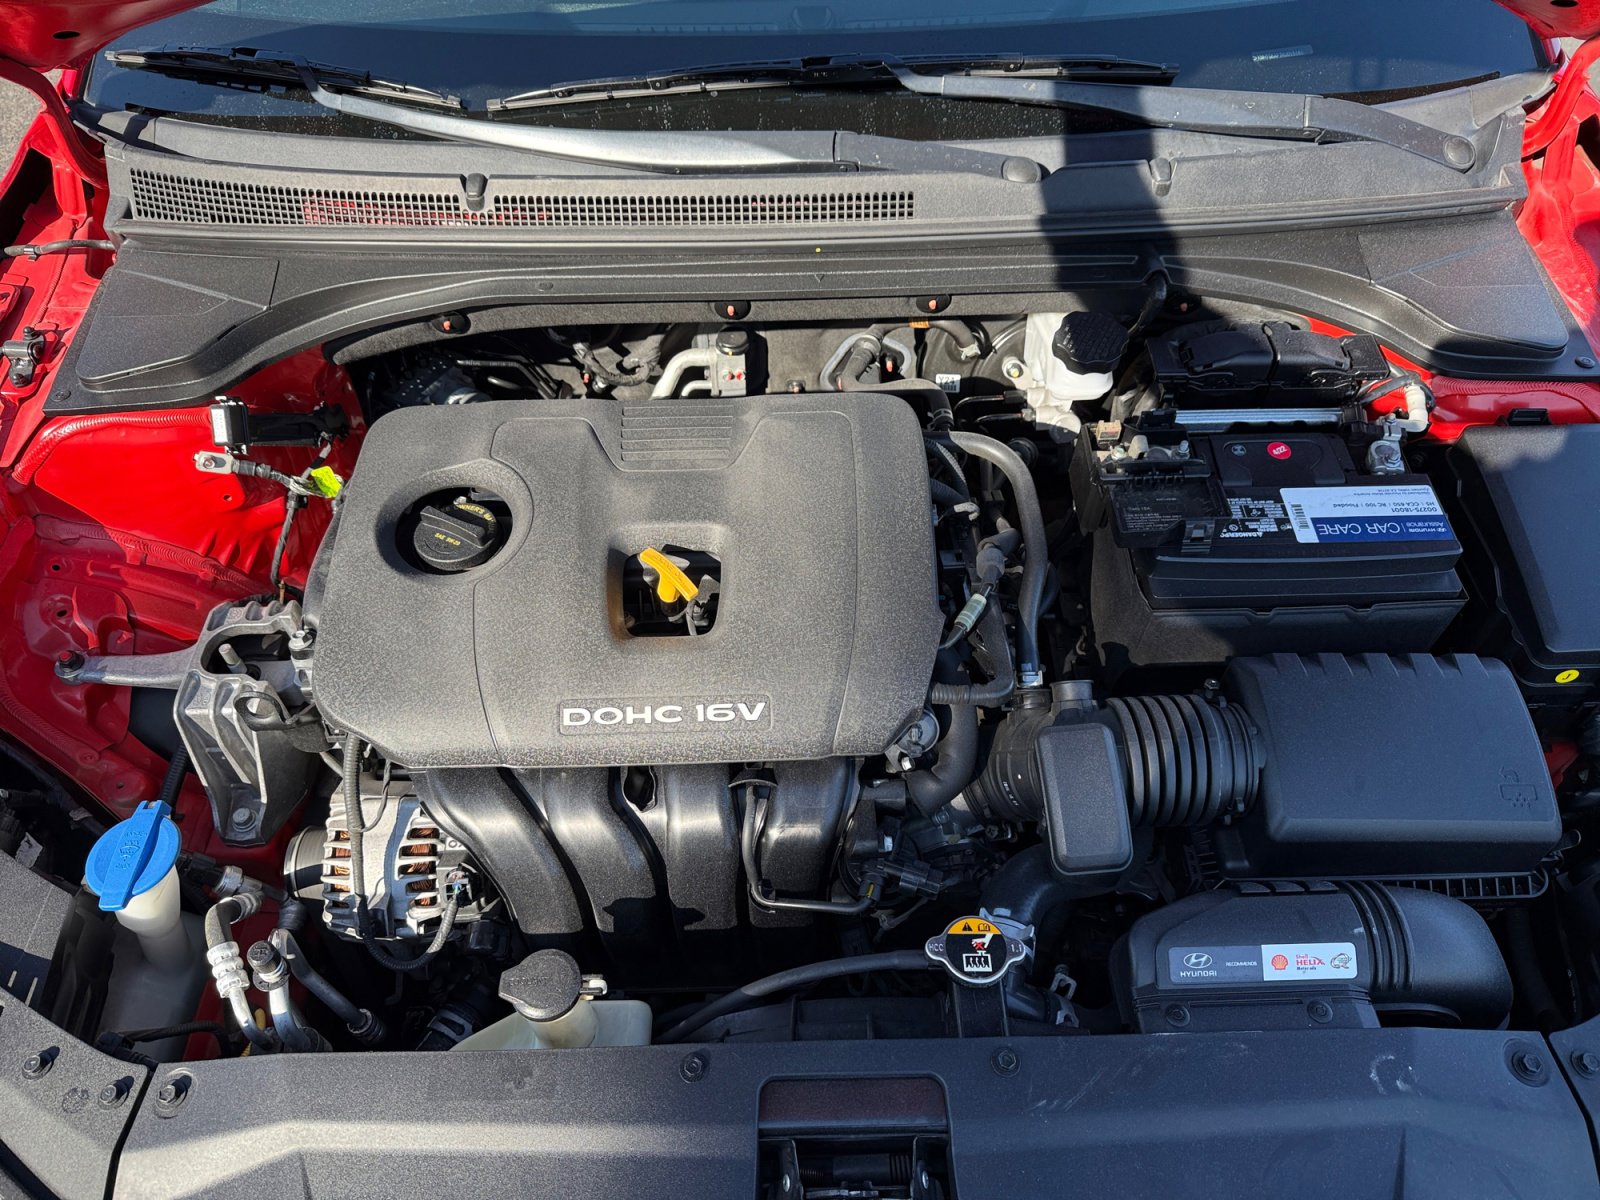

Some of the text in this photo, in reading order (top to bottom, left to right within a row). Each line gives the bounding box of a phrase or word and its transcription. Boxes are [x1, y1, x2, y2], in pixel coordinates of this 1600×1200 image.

[1315, 523, 1362, 535] CARE
[1364, 522, 1400, 534] CAR
[563, 702, 766, 726] DOHC 16V
[928, 943, 944, 952] HCC
[1010, 944, 1023, 953] 1.1
[1180, 970, 1217, 978] HYUNDAI
